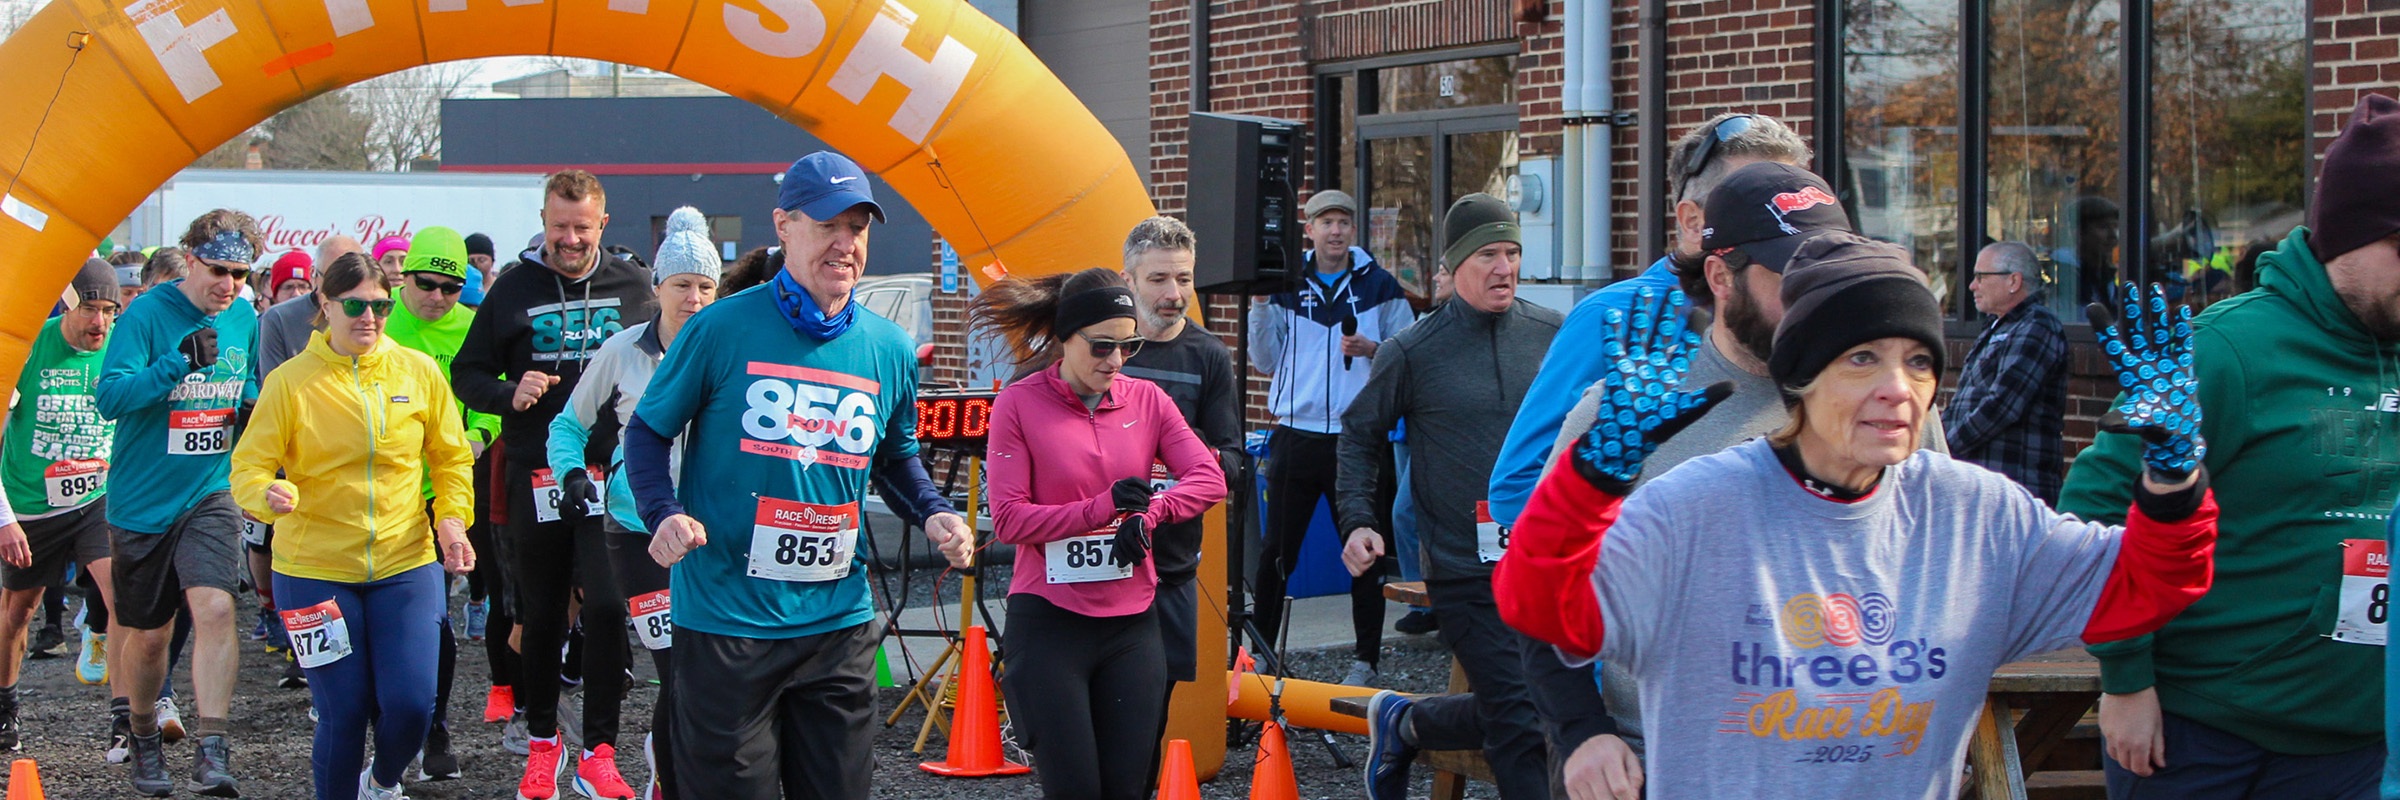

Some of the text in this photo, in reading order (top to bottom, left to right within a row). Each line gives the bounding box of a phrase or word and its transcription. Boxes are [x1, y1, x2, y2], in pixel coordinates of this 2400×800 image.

[1441, 77, 1452, 95] 50
[258, 215, 343, 252] Lucca'
[430, 257, 457, 271] 856
[531, 307, 624, 352] 856
[37, 394, 97, 412] OFFIC
[36, 411, 95, 424] SPORTS
[741, 378, 877, 454] 856
[786, 413, 848, 437] RUN
[60, 424, 104, 436] OF THE
[184, 431, 223, 452] 858
[753, 444, 861, 467] SOUTH JERSEY
[61, 475, 97, 497] 893
[775, 508, 803, 522] RACE
[775, 533, 836, 567] 853
[1066, 538, 1116, 568] 857
[638, 599, 657, 610] RACE
[647, 613, 672, 638] 85
[294, 629, 331, 657] 872
[1732, 638, 1947, 687] three 3's
[1748, 686, 1935, 756] Race Day
[1811, 745, 1875, 763] 2025
